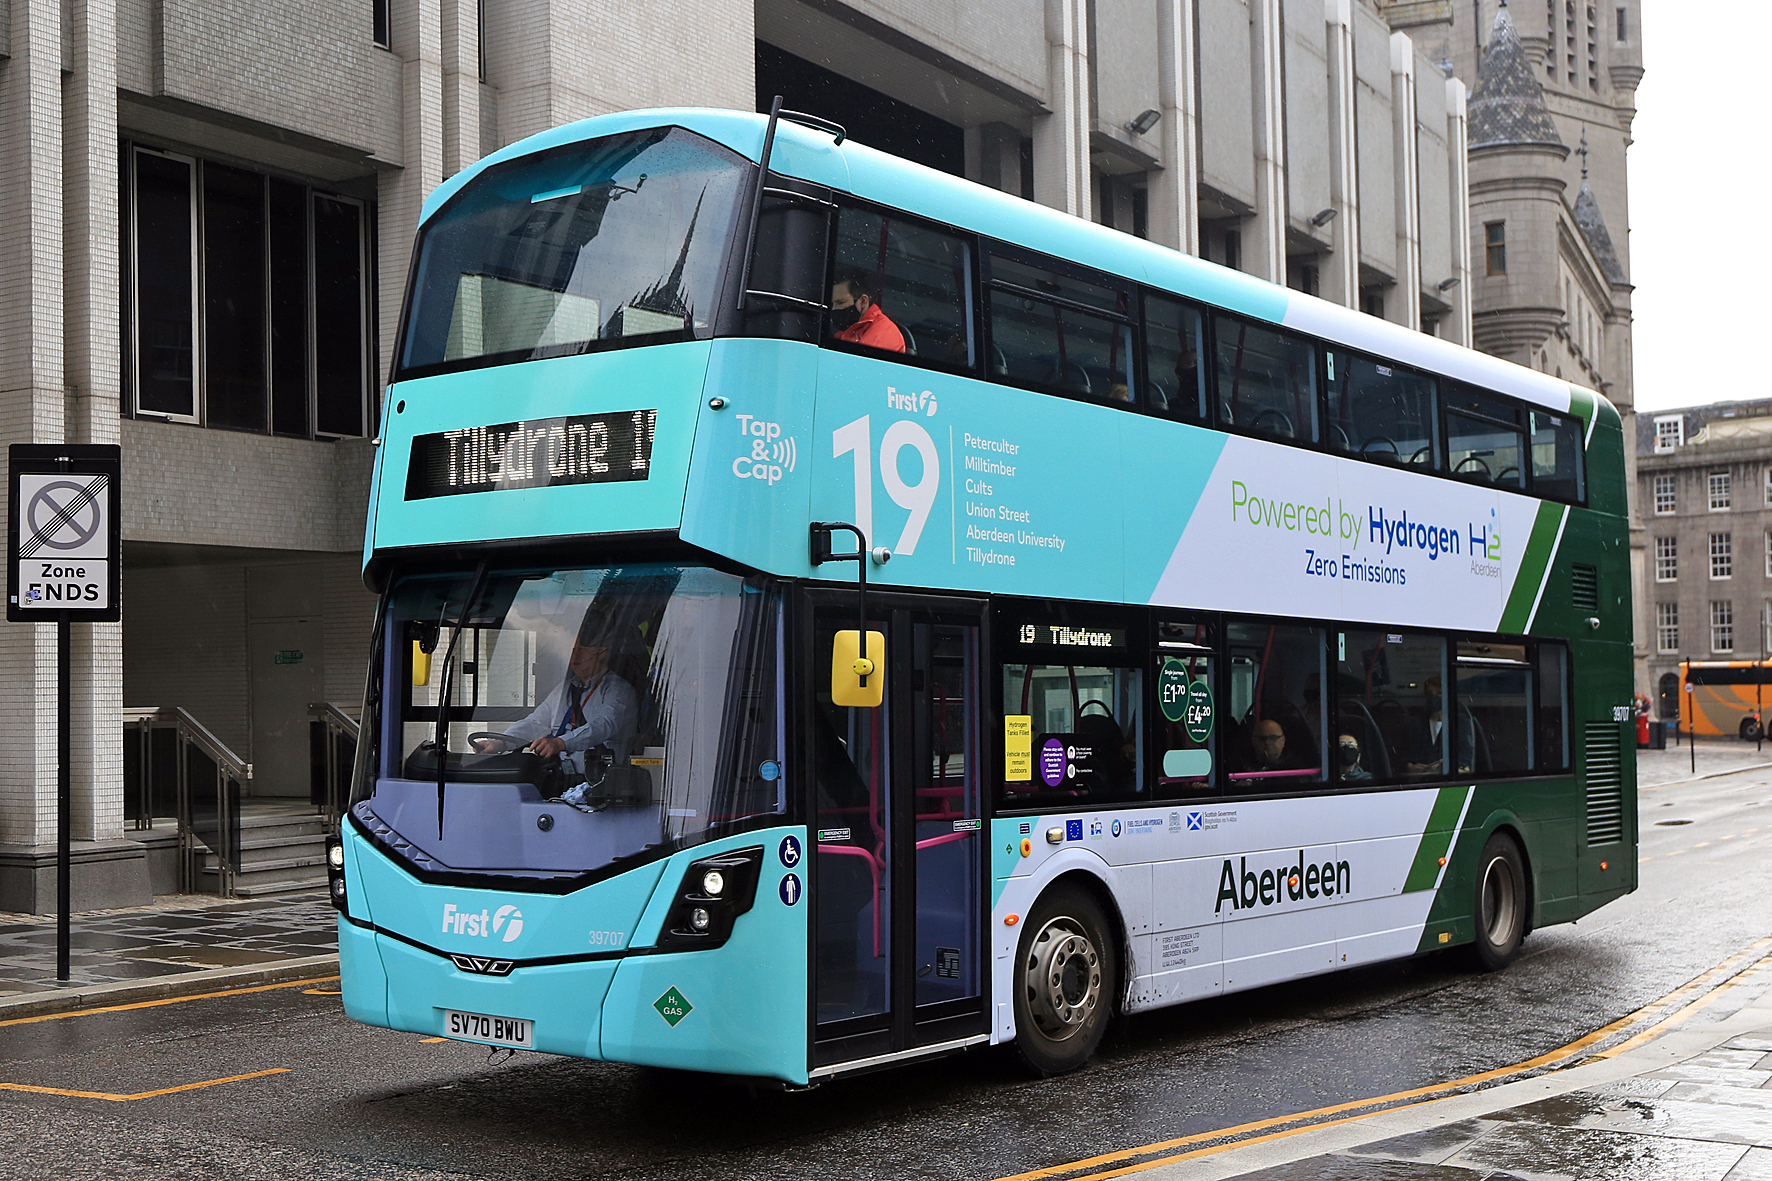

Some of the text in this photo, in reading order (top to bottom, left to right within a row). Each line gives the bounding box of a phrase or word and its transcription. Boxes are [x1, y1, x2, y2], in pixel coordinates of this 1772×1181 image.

[887, 386, 918, 413] First
[735, 414, 782, 439] Tap
[443, 421, 609, 487] Tillydrone
[752, 439, 770, 461] &
[964, 432, 1020, 455] Peterculter
[732, 456, 783, 486] Cap
[965, 455, 1017, 477] Milltimber
[832, 413, 940, 556] 19
[965, 479, 993, 496] Cults
[966, 501, 1030, 523] Union Street
[1232, 480, 1460, 561] Powered by Hydrogen
[966, 524, 1066, 552] Aberdeen University
[966, 546, 1016, 566] Tillydrone
[1305, 549, 1406, 585] Zero Emissions
[41, 563, 86, 579] Zone
[1470, 559, 1501, 578] Aberdeen
[29, 583, 99, 602] ENDS
[1019, 624, 1113, 647] 19 Tillydrone
[1163, 683, 1186, 703] £1.70
[1187, 705, 1211, 725] £4.20
[1613, 706, 1630, 721] 39707
[1214, 849, 1351, 914] Aberdeen
[442, 903, 489, 938] First
[588, 930, 625, 947] 39707
[663, 1006, 683, 1016] GAS
[668, 995, 679, 1006] H2
[451, 1013, 526, 1043] SV70 BWU
